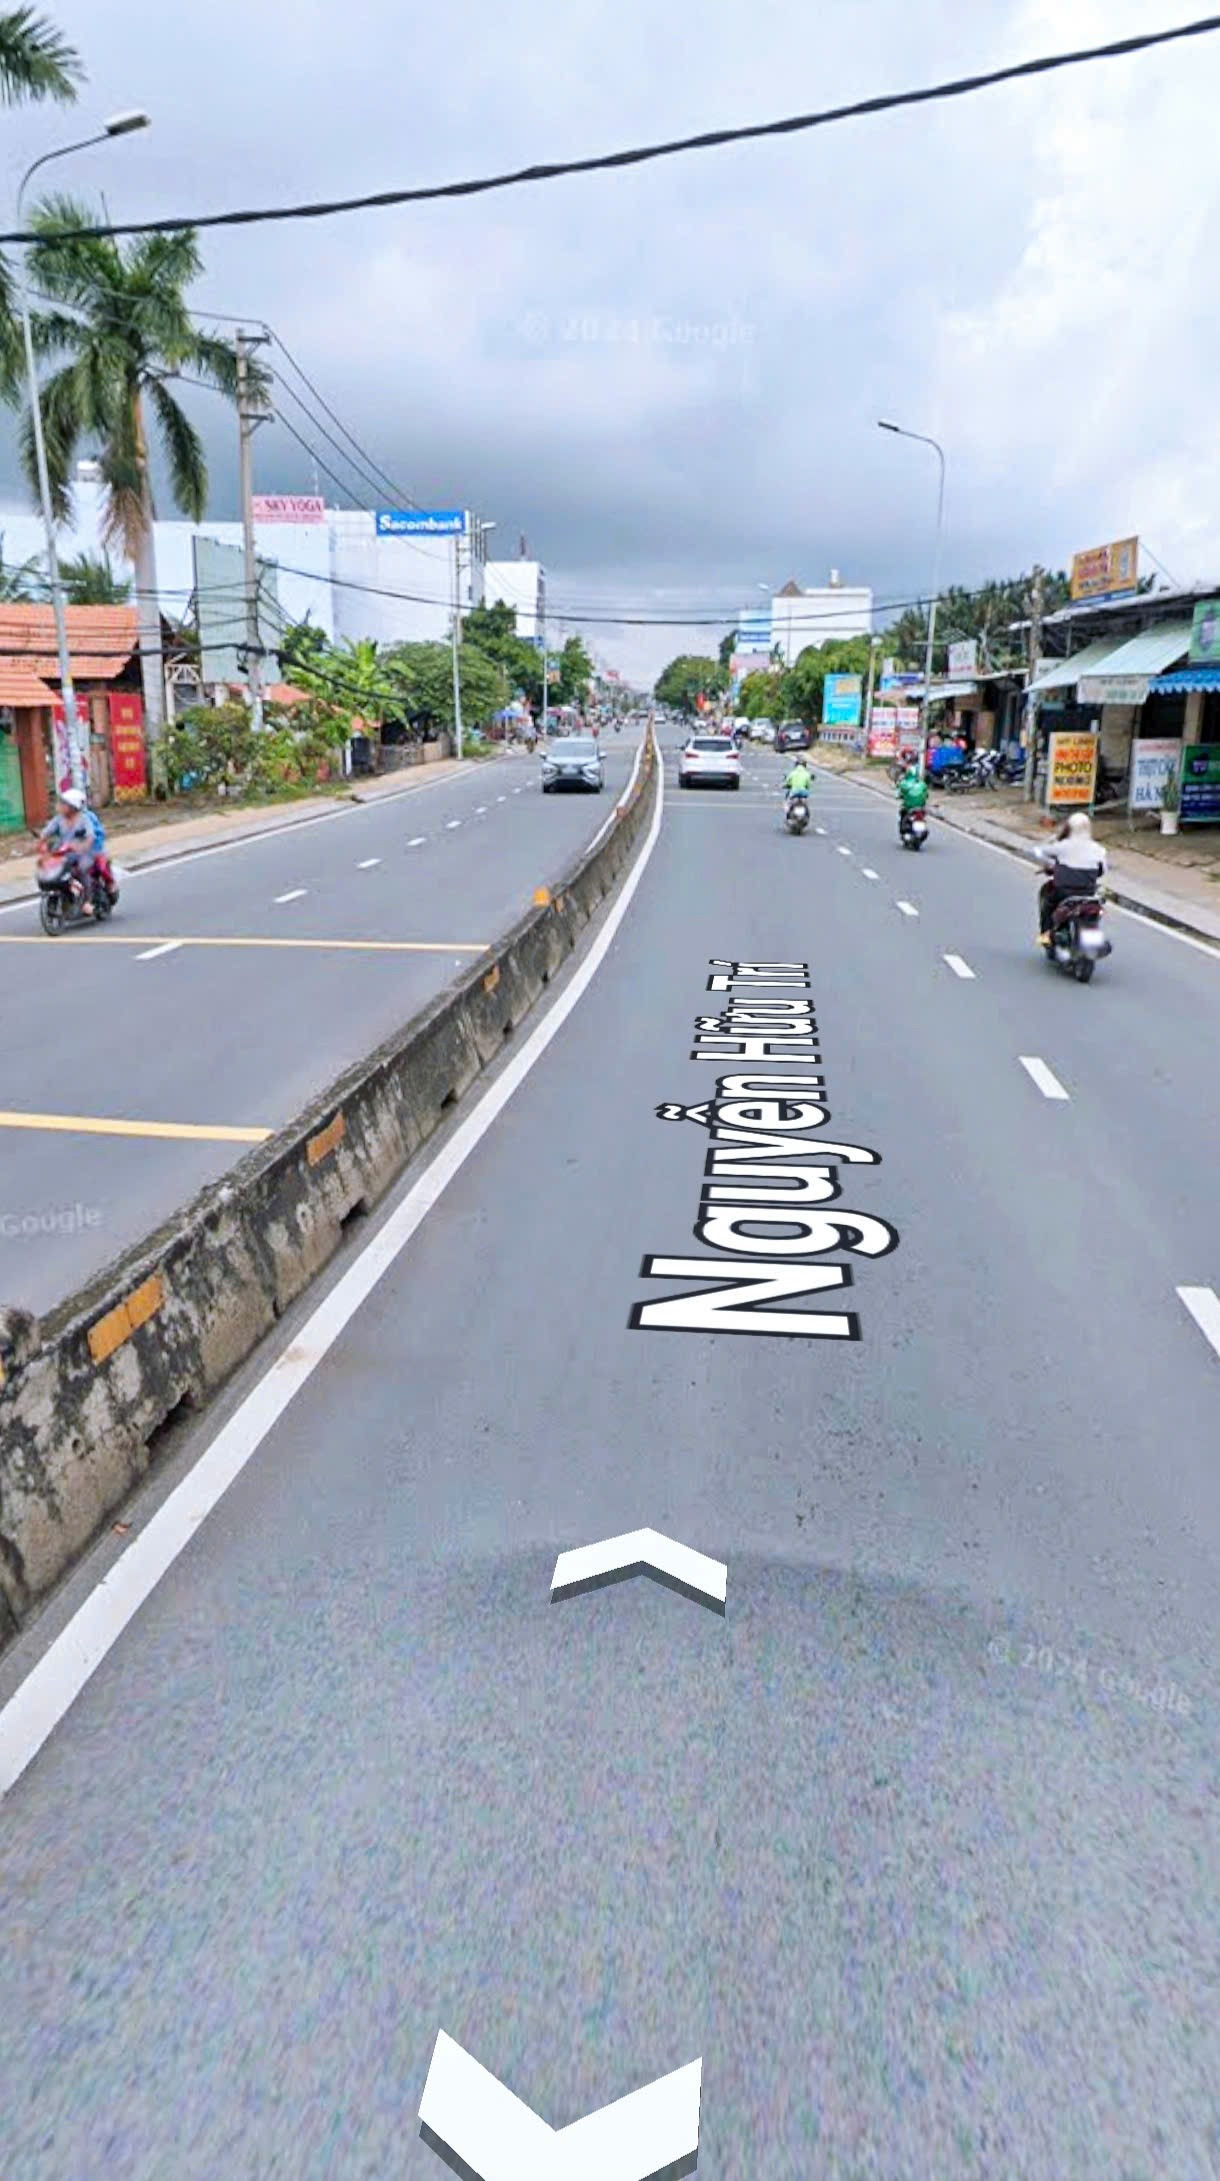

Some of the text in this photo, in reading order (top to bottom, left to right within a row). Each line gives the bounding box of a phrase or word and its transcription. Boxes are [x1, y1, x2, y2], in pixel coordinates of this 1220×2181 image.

[290, 498, 322, 513] YOGA
[379, 515, 463, 531] Sacombank
[1054, 761, 1093, 774] PHOTO
